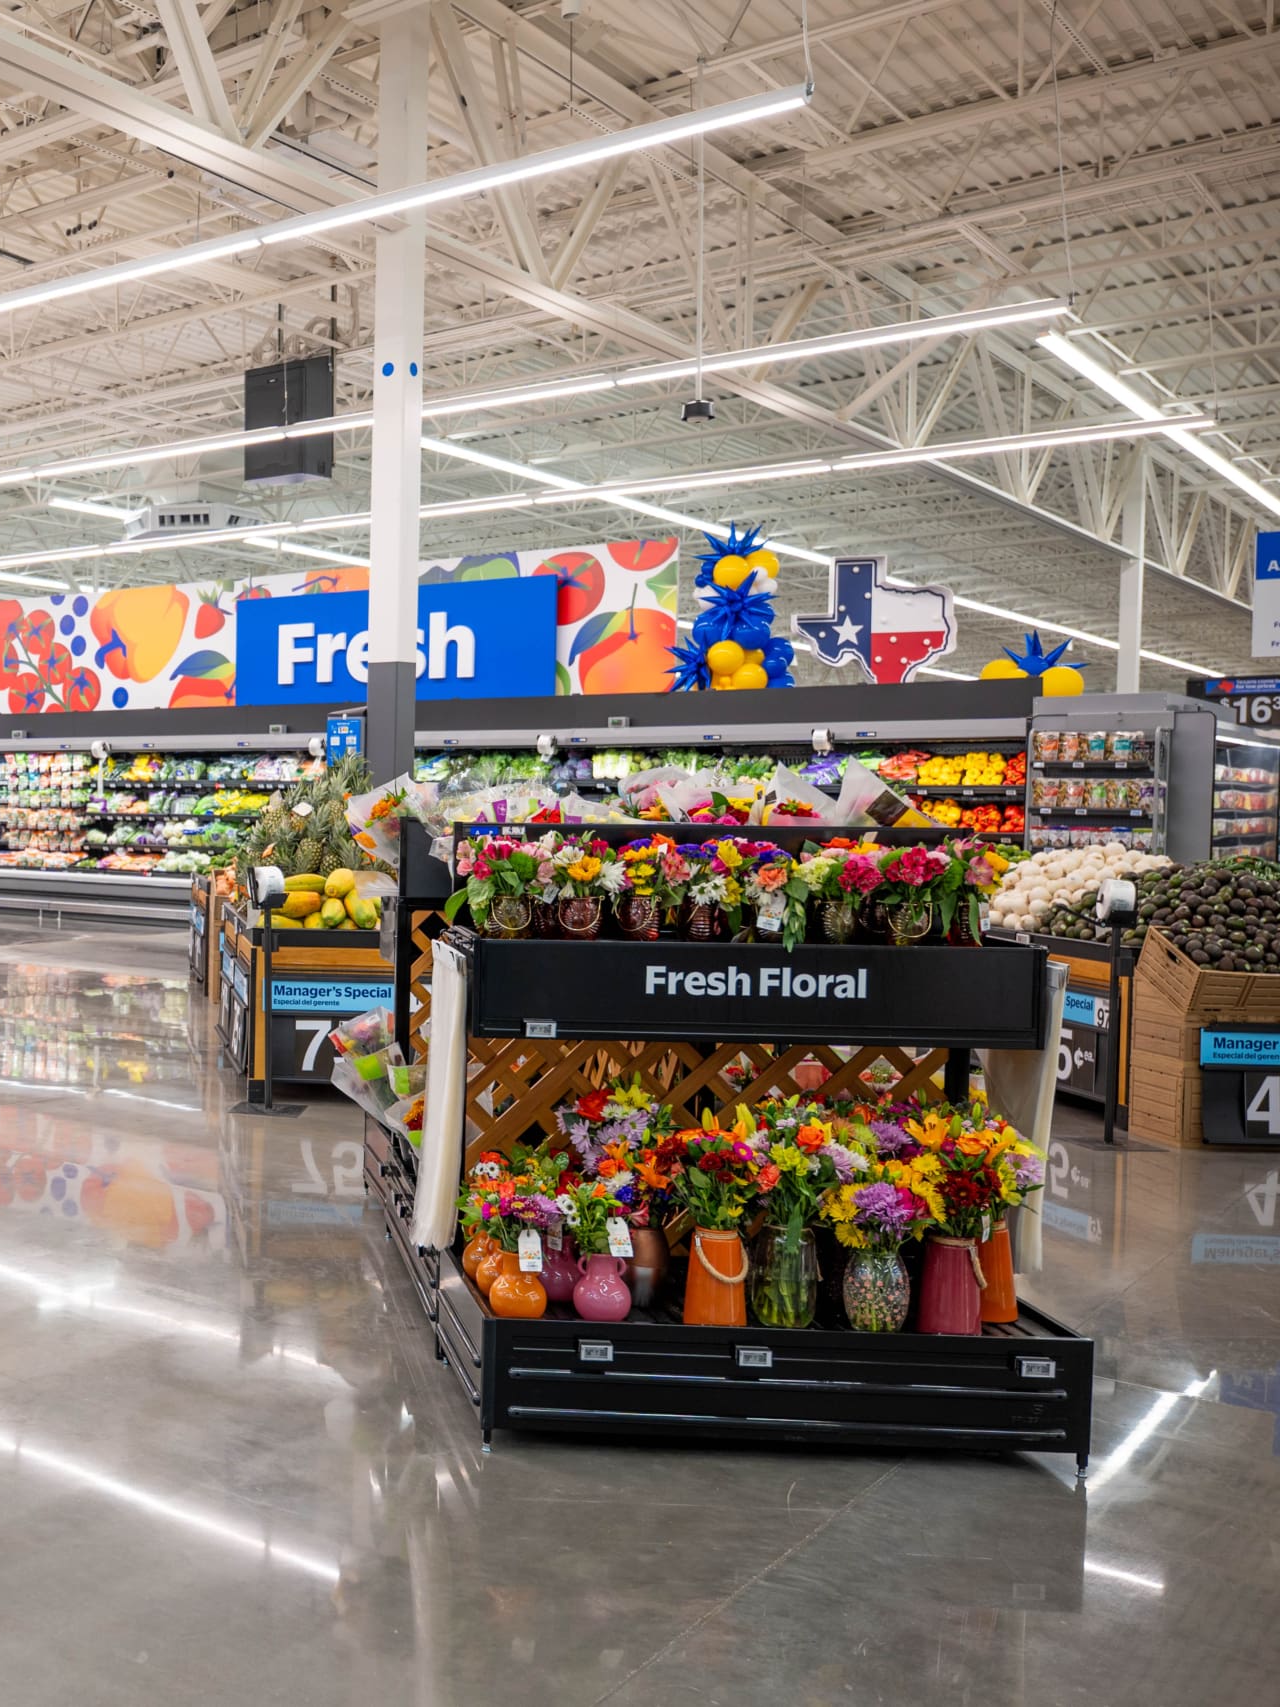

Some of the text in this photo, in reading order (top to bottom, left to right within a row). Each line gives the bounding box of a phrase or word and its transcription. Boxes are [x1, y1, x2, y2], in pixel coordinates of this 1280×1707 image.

[645, 965, 868, 999] Fresh Floral
[273, 984, 392, 1000] Manager's Special
[273, 998, 301, 1007] Especial
[1065, 995, 1094, 1011] Special
[1212, 1052, 1244, 1061] Especial
